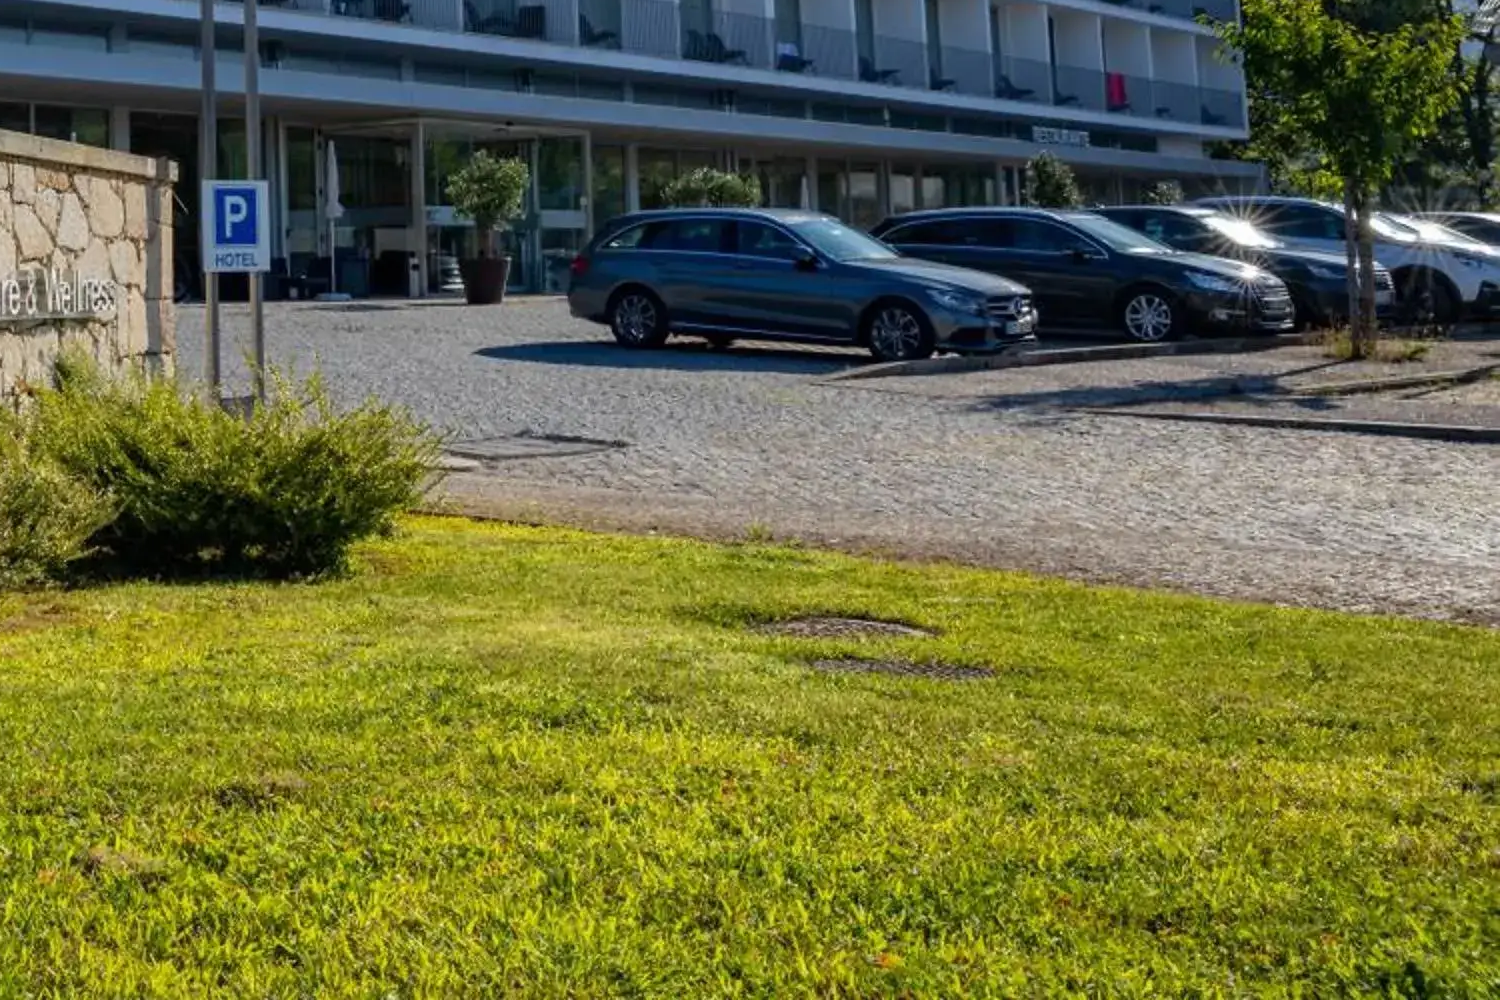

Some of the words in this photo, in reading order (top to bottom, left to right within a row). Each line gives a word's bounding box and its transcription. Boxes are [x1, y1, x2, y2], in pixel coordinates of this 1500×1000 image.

[224, 195, 247, 238] P
[216, 252, 257, 267] HOTEL
[43, 266, 118, 314] Wellness
